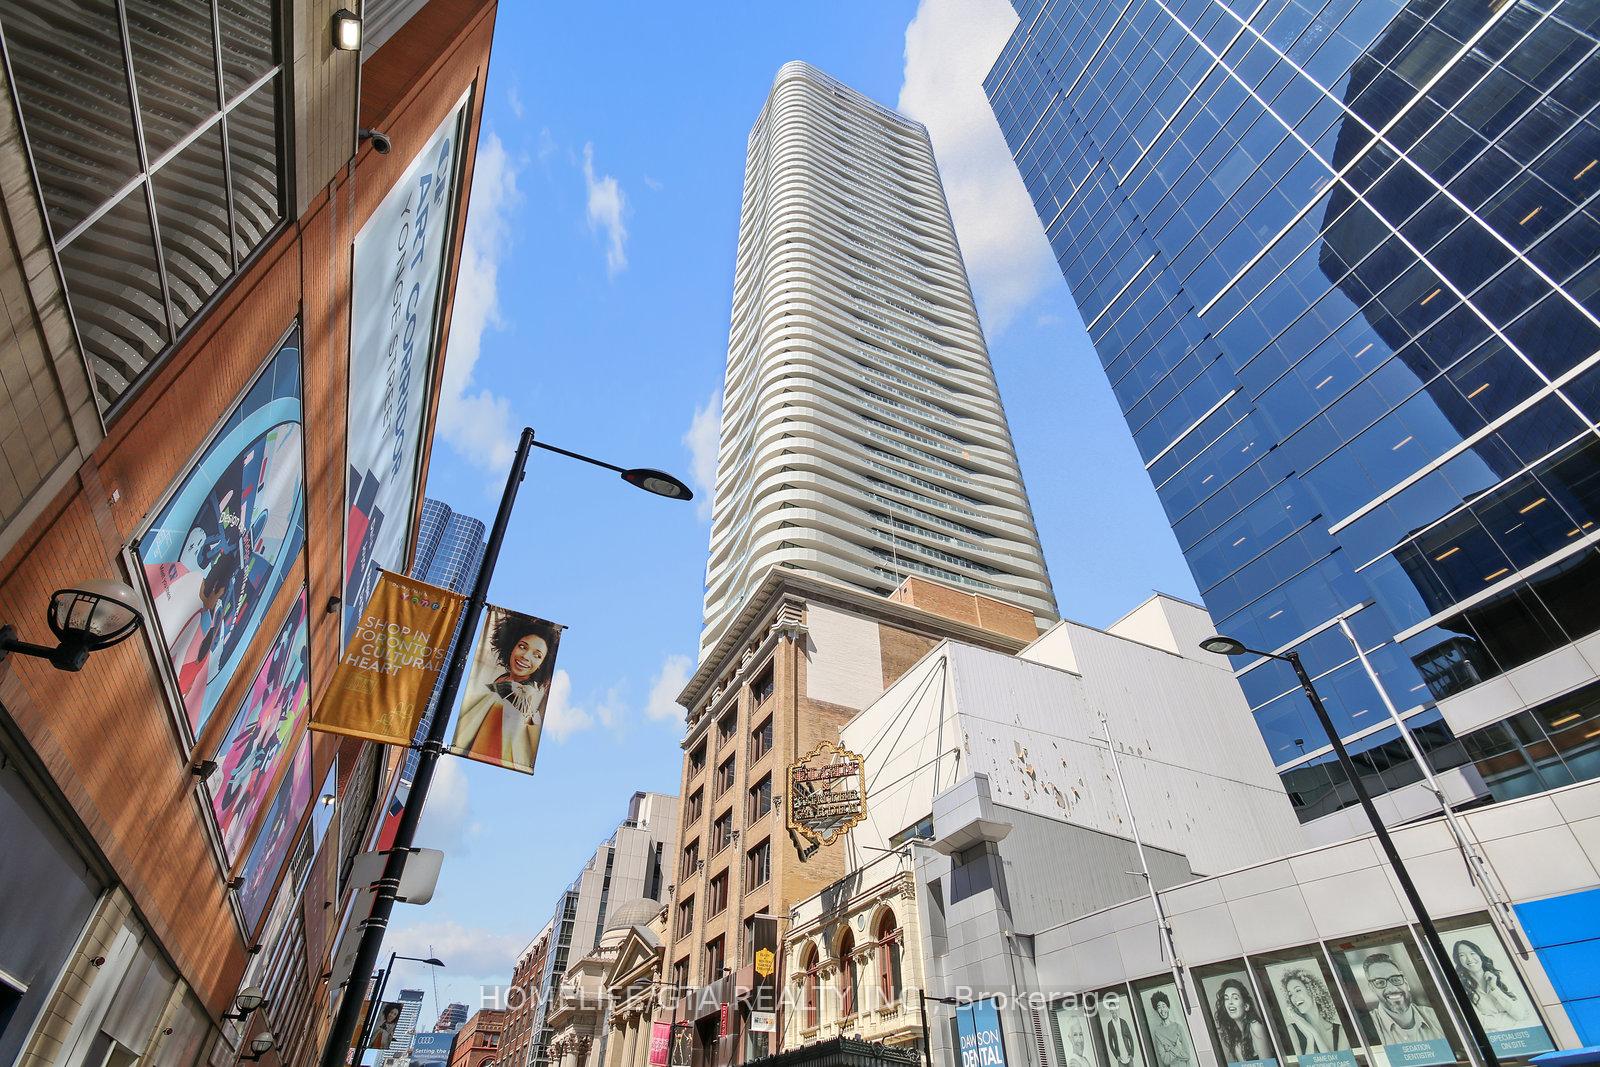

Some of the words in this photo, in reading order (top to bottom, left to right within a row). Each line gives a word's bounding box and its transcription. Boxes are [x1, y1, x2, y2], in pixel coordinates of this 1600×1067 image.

[411, 173, 433, 271] ART
[391, 191, 413, 331] YONGE
[382, 334, 399, 440] STREET
[390, 281, 420, 485] CORRIDOR
[355, 626, 446, 660] TORONTO'S
[365, 616, 411, 635] SHOP
[413, 630, 431, 644] IN
[345, 653, 402, 677] HEART
[361, 644, 442, 673] CULTURAL
[961, 1029, 999, 1050] DAWSON
[1402, 1044, 1431, 1053] SEDATION
[1490, 1031, 1530, 1042] SPECIALISTS
[962, 1046, 1003, 1067] DENTAL
[1404, 1051, 1436, 1060] DENTISTRY
